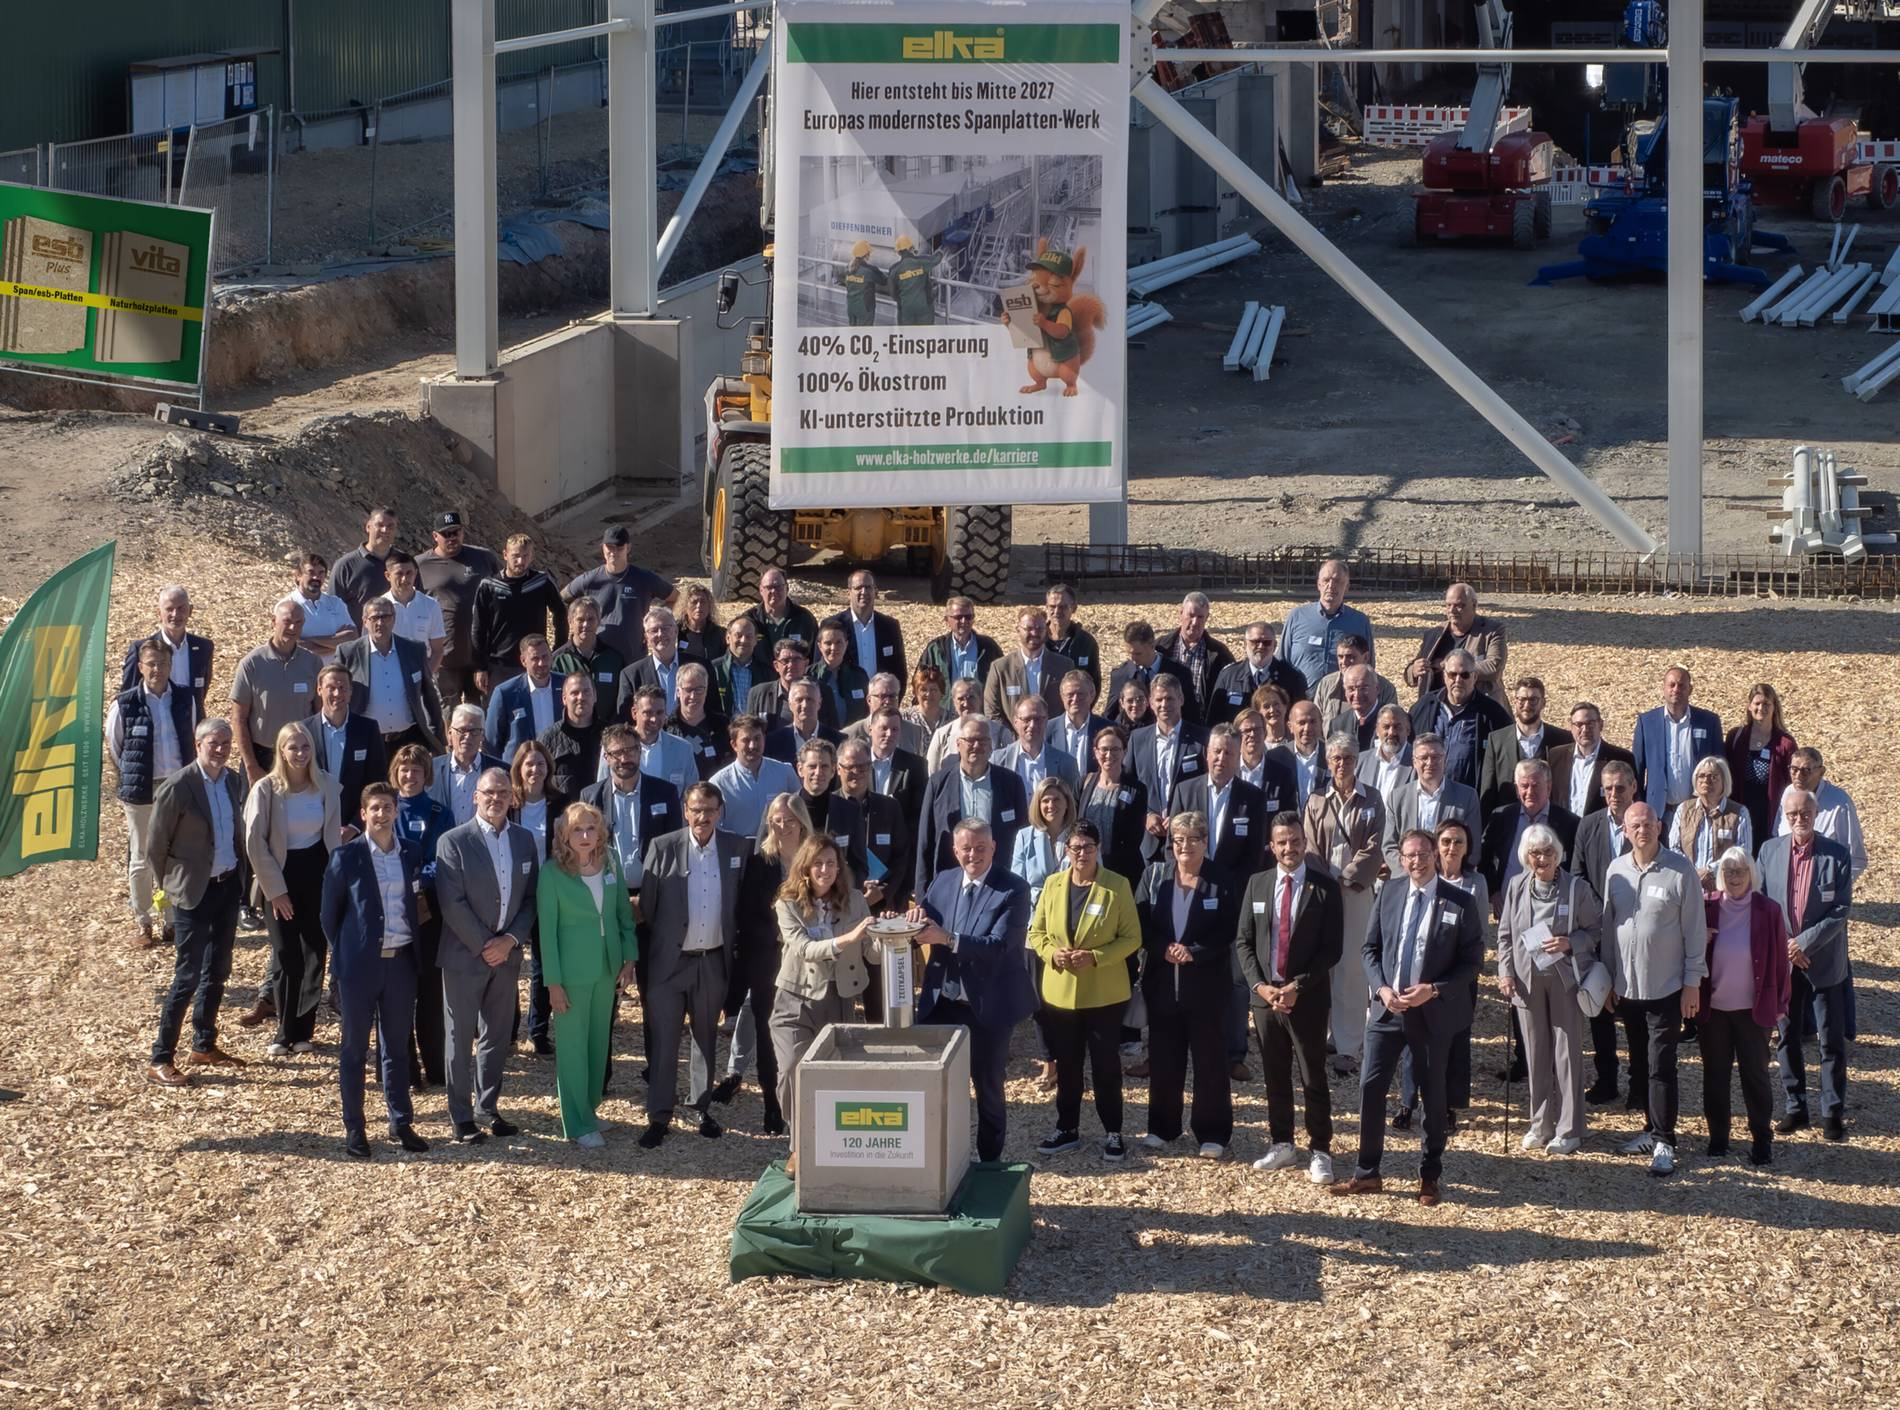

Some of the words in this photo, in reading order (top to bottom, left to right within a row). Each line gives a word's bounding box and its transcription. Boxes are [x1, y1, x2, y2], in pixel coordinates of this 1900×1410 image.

[902, 30, 1005, 59] elka
[851, 81, 881, 100] Hier
[884, 81, 948, 100] entsteht
[951, 81, 973, 100] bis
[976, 81, 1017, 100] Mitte
[1020, 81, 1055, 100] 2027
[803, 109, 865, 134] Europas
[868, 109, 961, 130] modernstes
[964, 108, 1100, 134] Spanplatten-Werk
[1760, 155, 1802, 164] mateco
[830, 221, 893, 236] DIEFFENBACHER
[32, 234, 85, 260] esb
[45, 261, 72, 274] Plus
[131, 245, 181, 273] vita
[13, 285, 83, 303] Span/esb-Platten
[1005, 294, 1032, 309] esb
[110, 298, 178, 316] Naturholzplatten
[798, 335, 845, 356] 40%
[797, 372, 854, 393] 100%
[858, 367, 947, 393] Ökostrom
[799, 408, 941, 430] KI-unterstützte
[945, 405, 1044, 427] Produktion
[855, 449, 1039, 466] www.elka-holzwerke.de/karriere
[840, 1107, 903, 1126] elka
[842, 1137, 863, 1148] 120
[865, 1137, 902, 1149] JAHRE
[830, 1150, 865, 1159] Investition
[867, 1151, 873, 1159] in
[876, 1151, 886, 1159] die
[887, 1150, 913, 1160] Zukunft
